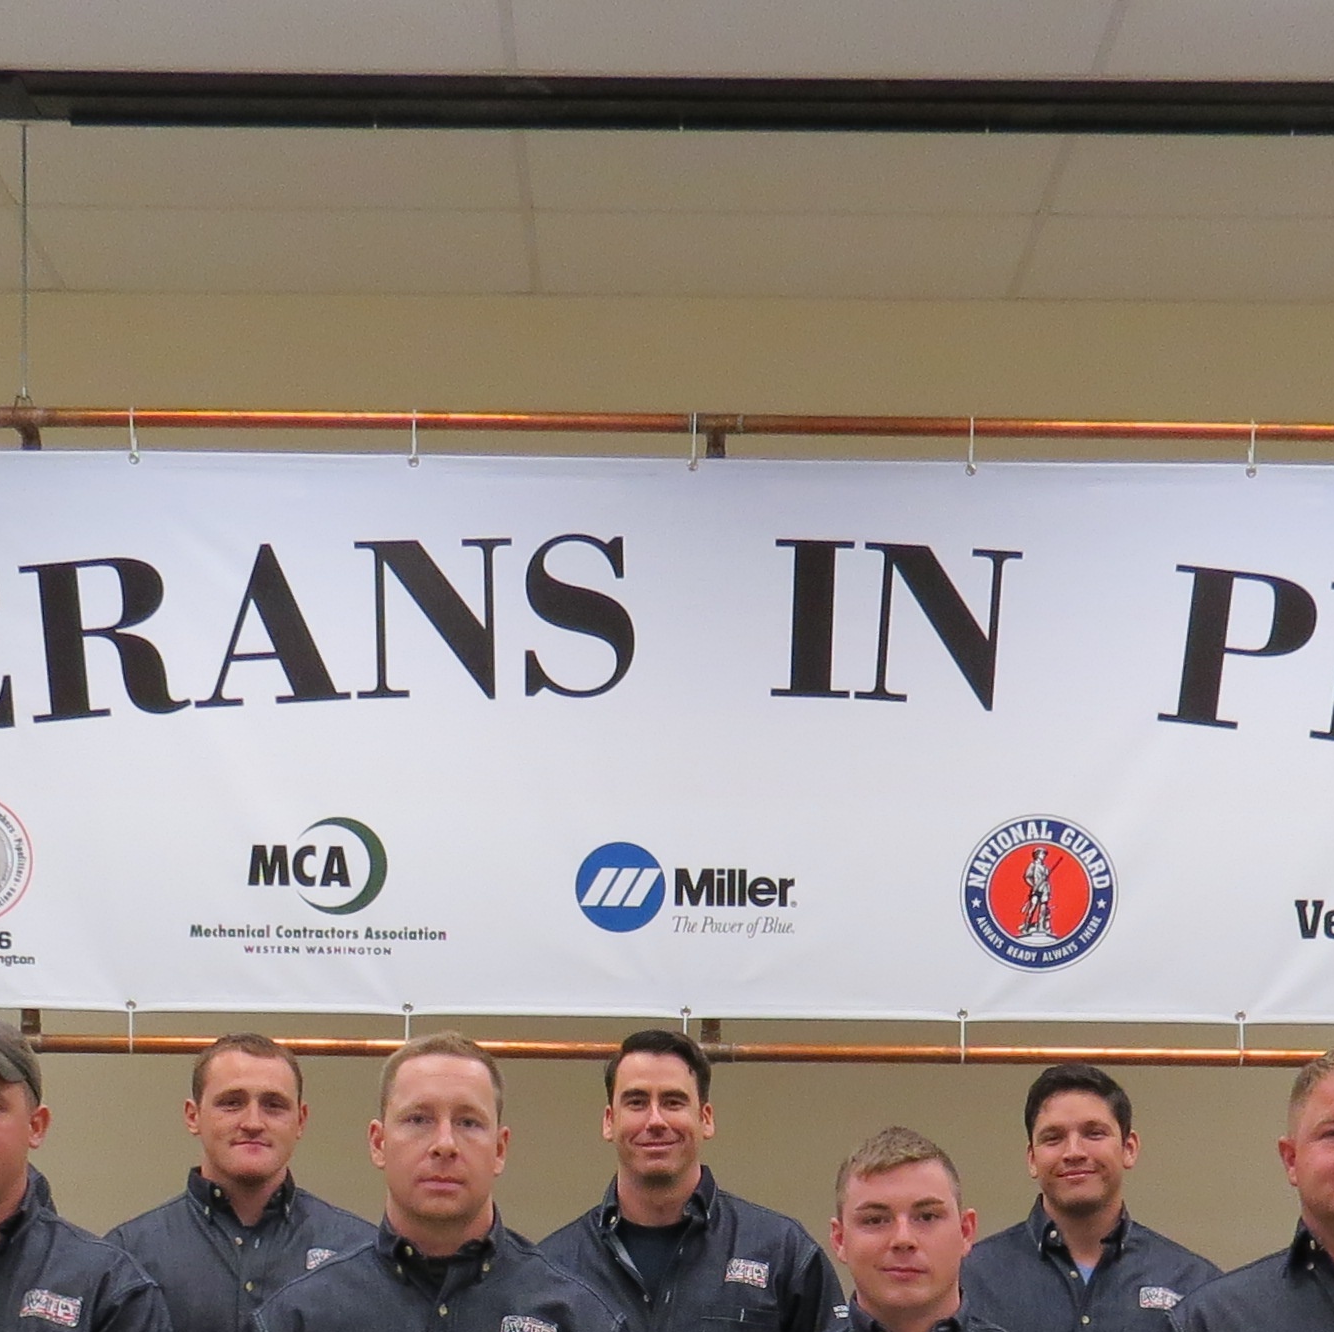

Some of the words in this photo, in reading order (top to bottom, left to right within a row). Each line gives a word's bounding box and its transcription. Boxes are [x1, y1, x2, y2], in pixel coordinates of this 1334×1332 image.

[771, 538, 1023, 710] IN
[247, 844, 351, 887] MCA
[967, 821, 1053, 889] NATIONAL
[1060, 827, 1111, 890] GUARD
[190, 924, 271, 938] Mechanical
[276, 925, 359, 940] Contractors
[364, 927, 447, 941] Association
[672, 915, 698, 934] The
[700, 916, 744, 934] Power
[746, 916, 762, 939] of
[976, 916, 1005, 949] ALWAYS
[1006, 945, 1038, 962] READY
[1042, 942, 1079, 962] ALWAYS
[243, 945, 301, 954] WESTERN
[306, 945, 392, 955] WASHINGTON
